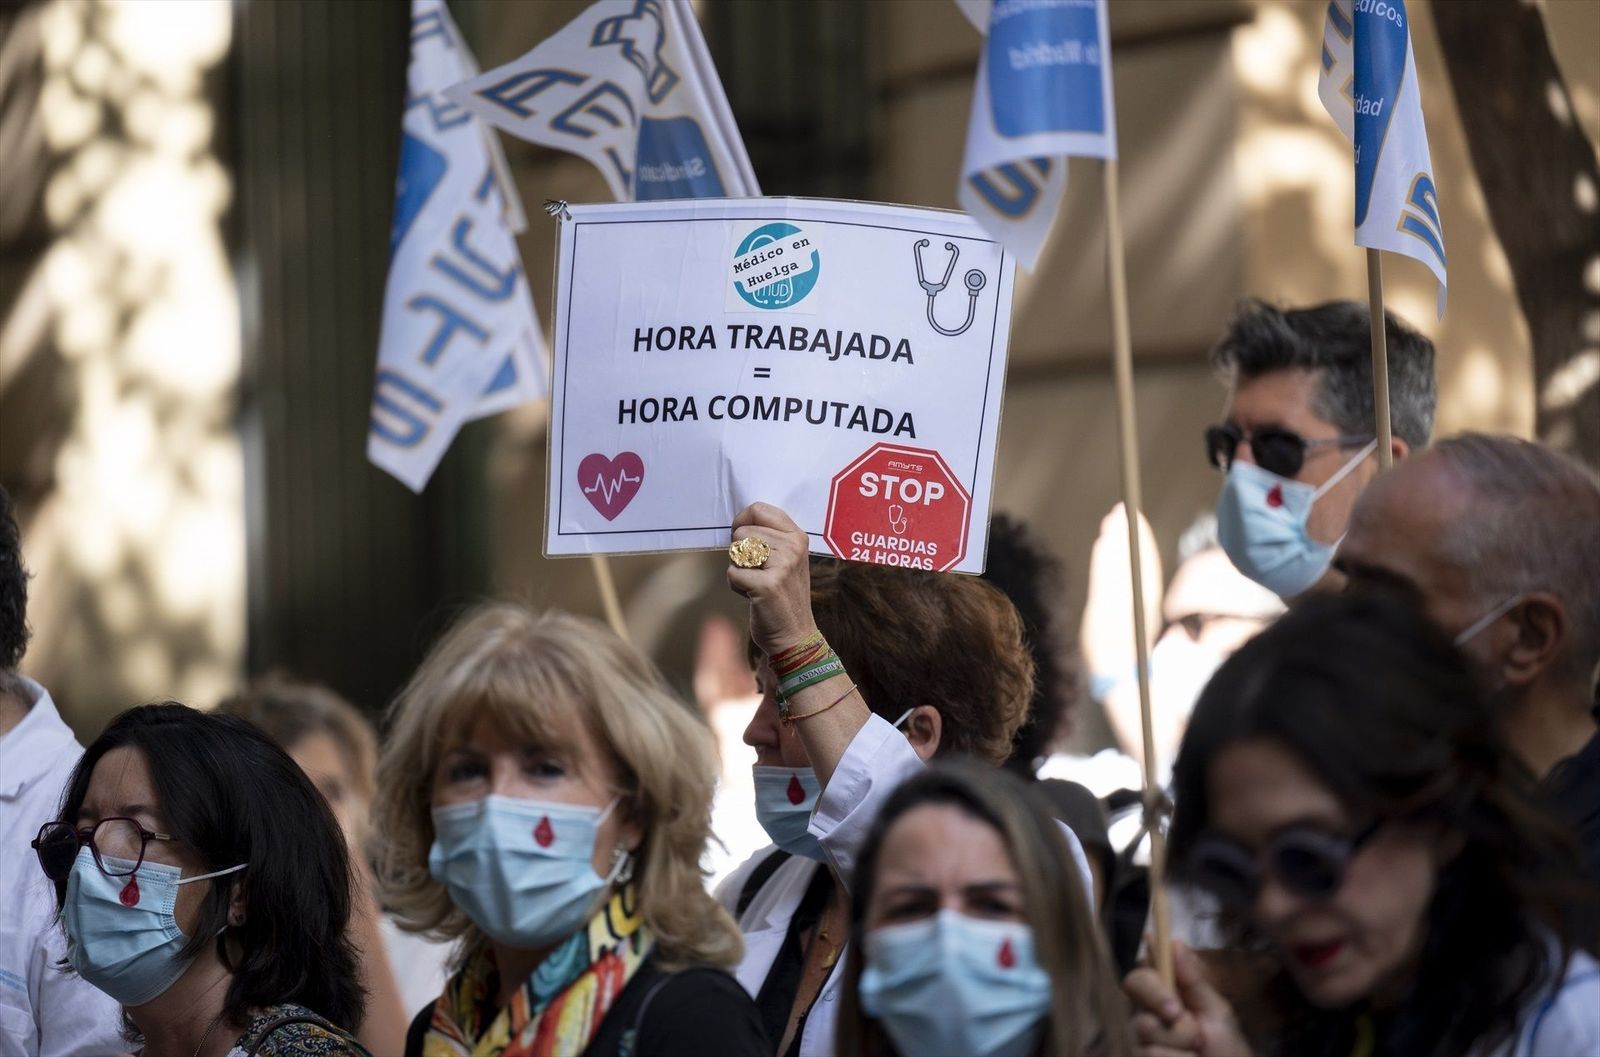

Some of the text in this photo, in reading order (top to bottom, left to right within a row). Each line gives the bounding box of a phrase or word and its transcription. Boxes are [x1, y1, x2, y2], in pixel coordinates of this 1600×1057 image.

[733, 237, 811, 274] Médico en
[746, 261, 799, 288] Huelga
[633, 323, 915, 365] HORA TRABAJADA
[753, 366, 772, 379] =
[618, 394, 917, 439] HORA COMPUTADA
[858, 471, 945, 506] STOP
[850, 531, 938, 556] GUARDIAS
[850, 547, 934, 571] 24 HORAS
